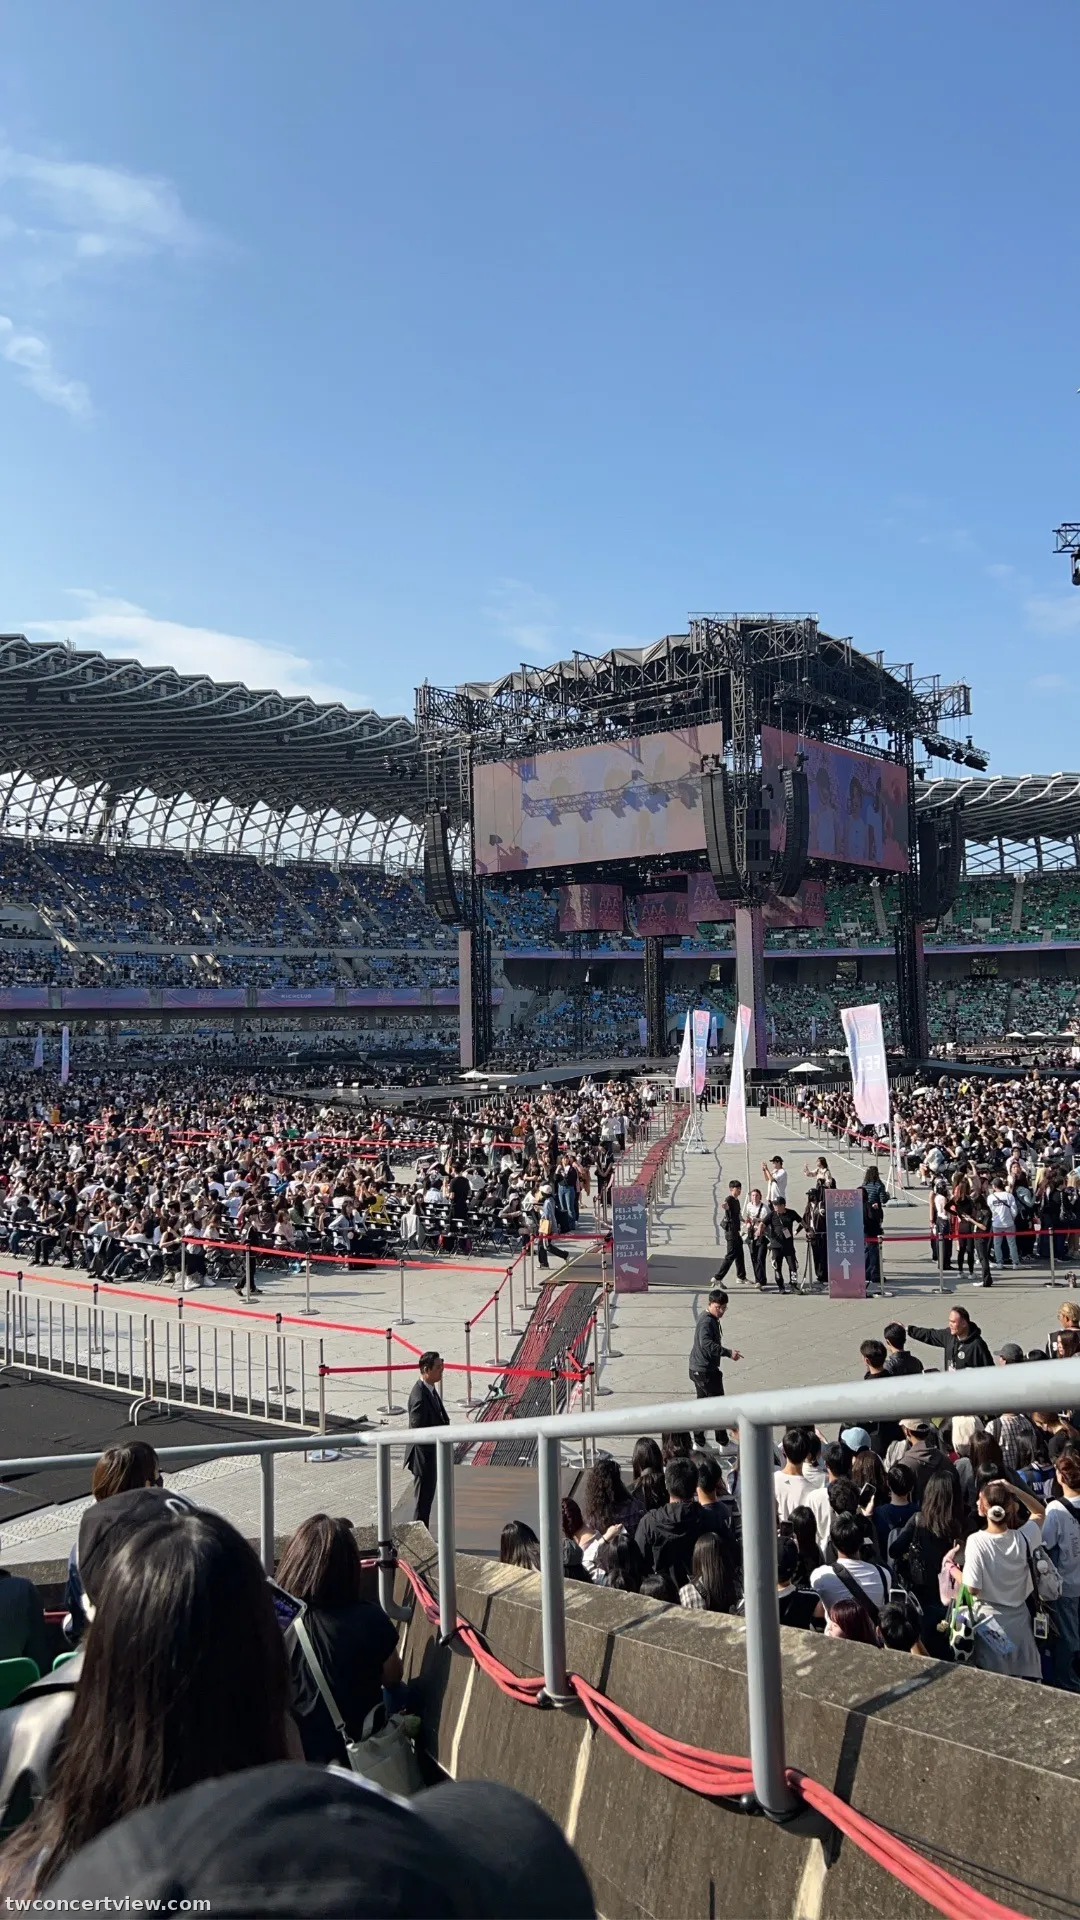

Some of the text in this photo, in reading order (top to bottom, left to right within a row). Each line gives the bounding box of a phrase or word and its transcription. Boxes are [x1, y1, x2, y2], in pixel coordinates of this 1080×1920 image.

[641, 903, 667, 917] AAA
[834, 1200, 855, 1208] 2025
[834, 1211, 845, 1219] FE
[835, 1231, 846, 1240] FS
[835, 1246, 855, 1254] 4.5.6
